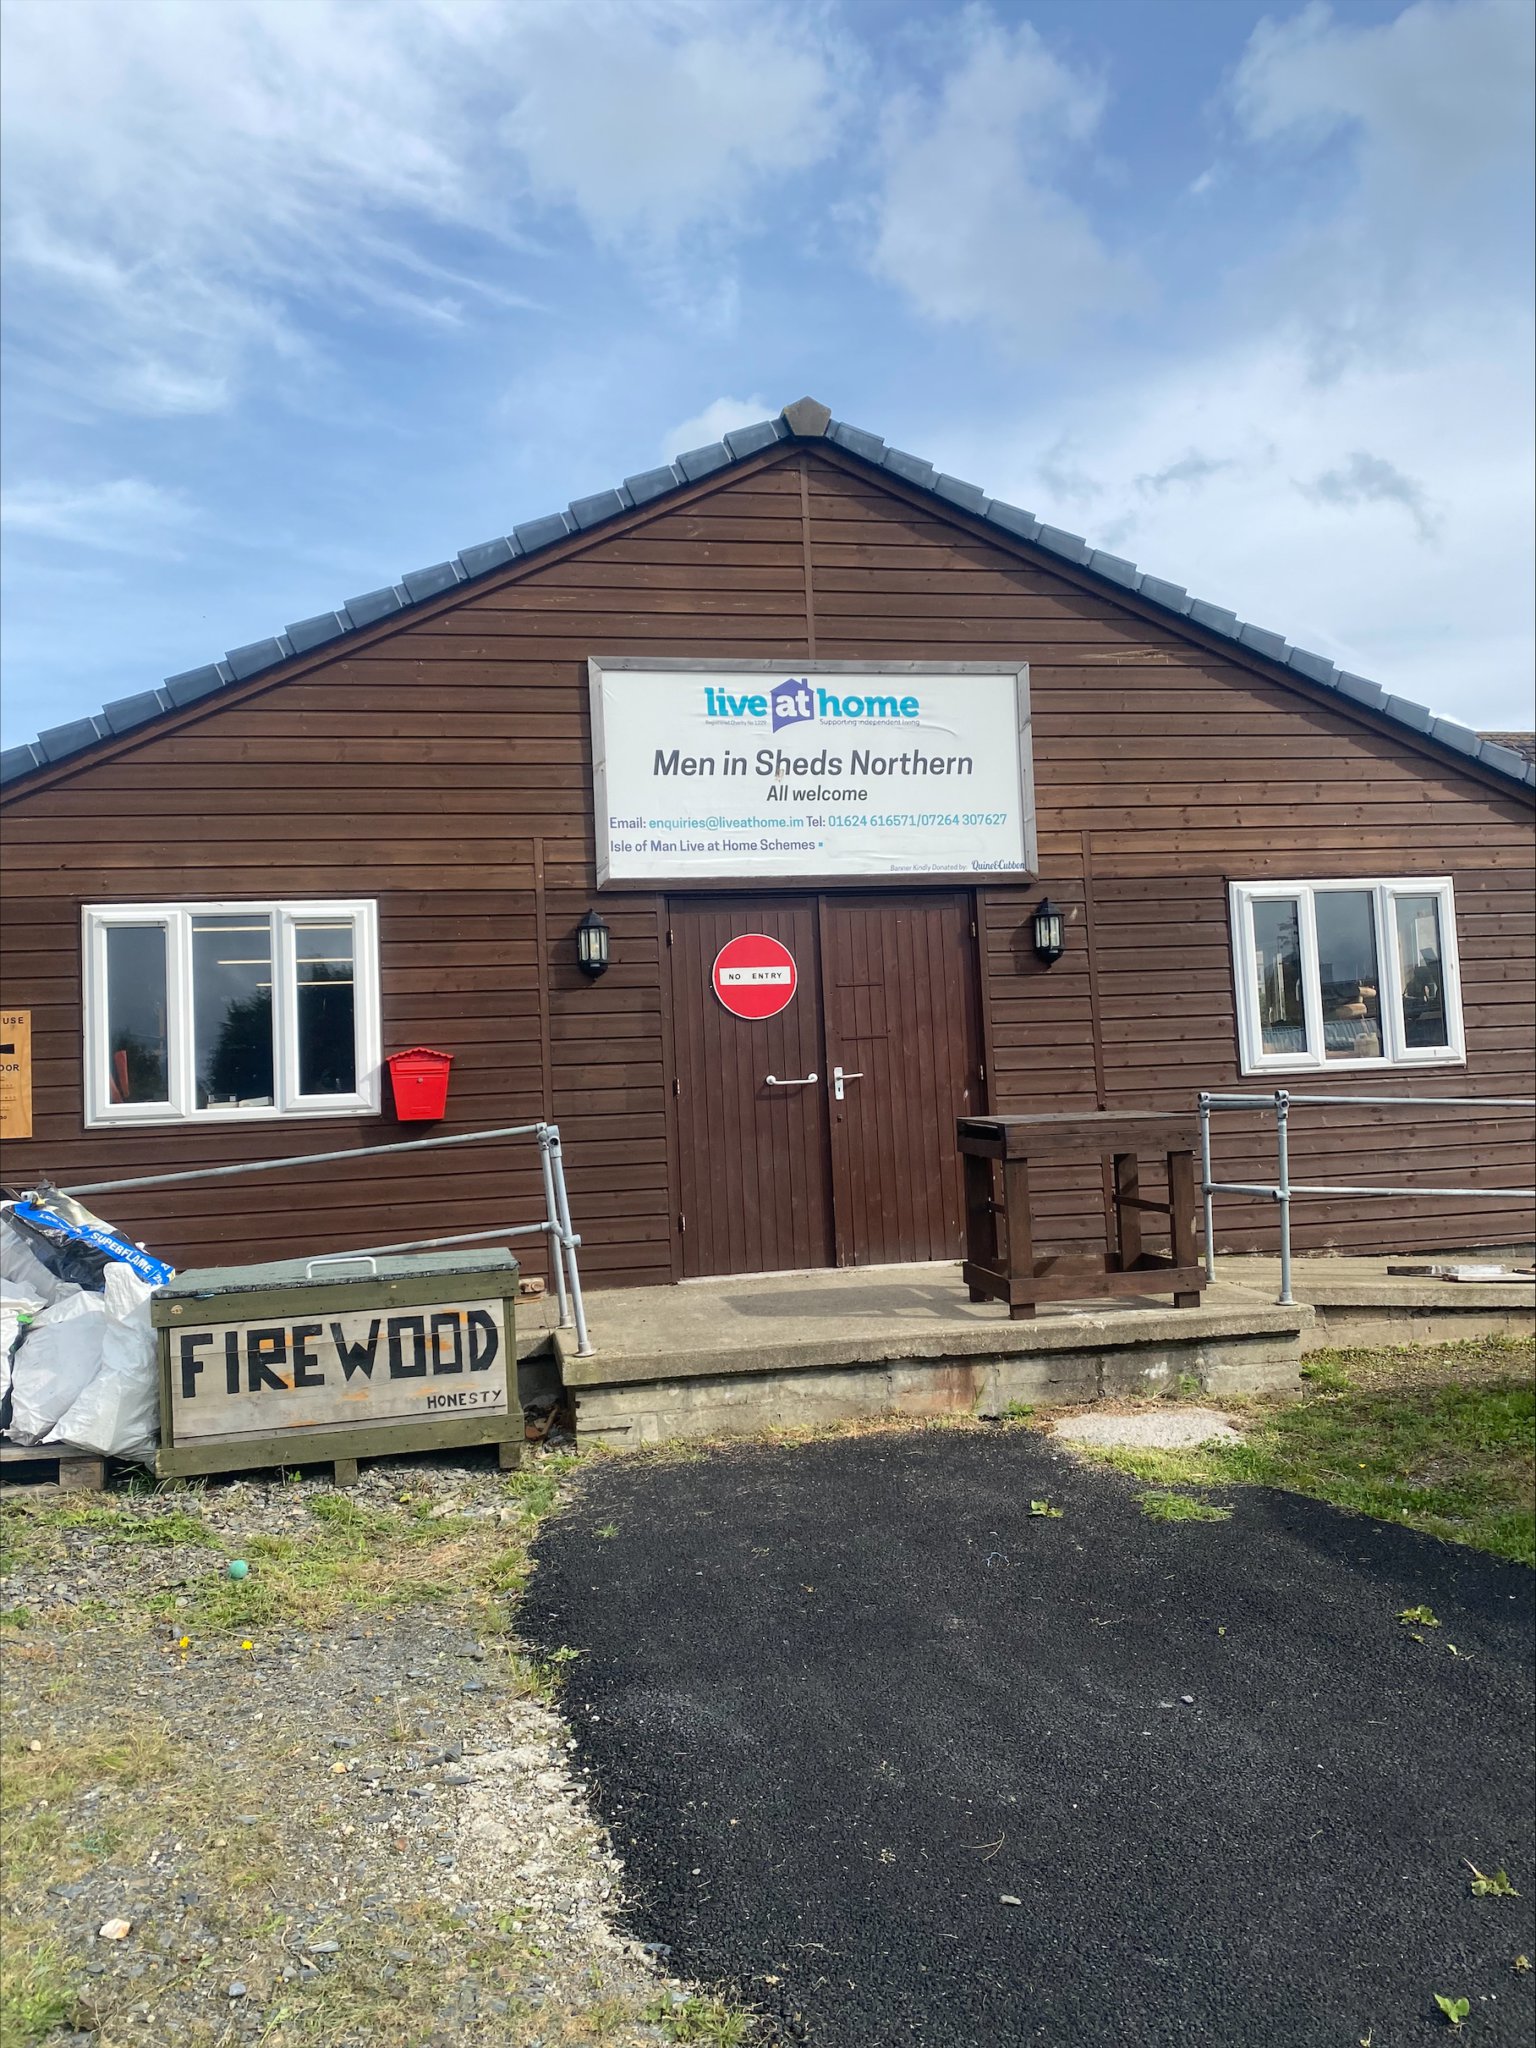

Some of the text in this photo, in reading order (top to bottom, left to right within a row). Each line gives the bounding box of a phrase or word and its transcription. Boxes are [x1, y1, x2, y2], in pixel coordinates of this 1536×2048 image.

[704, 687, 920, 718] live at home
[819, 718, 857, 727] Supporting
[858, 719, 901, 727] independent
[653, 749, 974, 776] Men in Sheds Northern
[766, 785, 868, 802] All welcome
[609, 813, 1008, 831] Email: enquiries@liveathome.im Tel: 01624 616571/07264 307627
[610, 838, 815, 853] Isle of Man Live at Home Schemes
[912, 864, 931, 872] Kindly
[932, 863, 958, 871] Donated
[91, 1232, 153, 1274] SUPERFLAME
[180, 1309, 499, 1399] FIREWOOD
[427, 1388, 503, 1410] HONESTY
